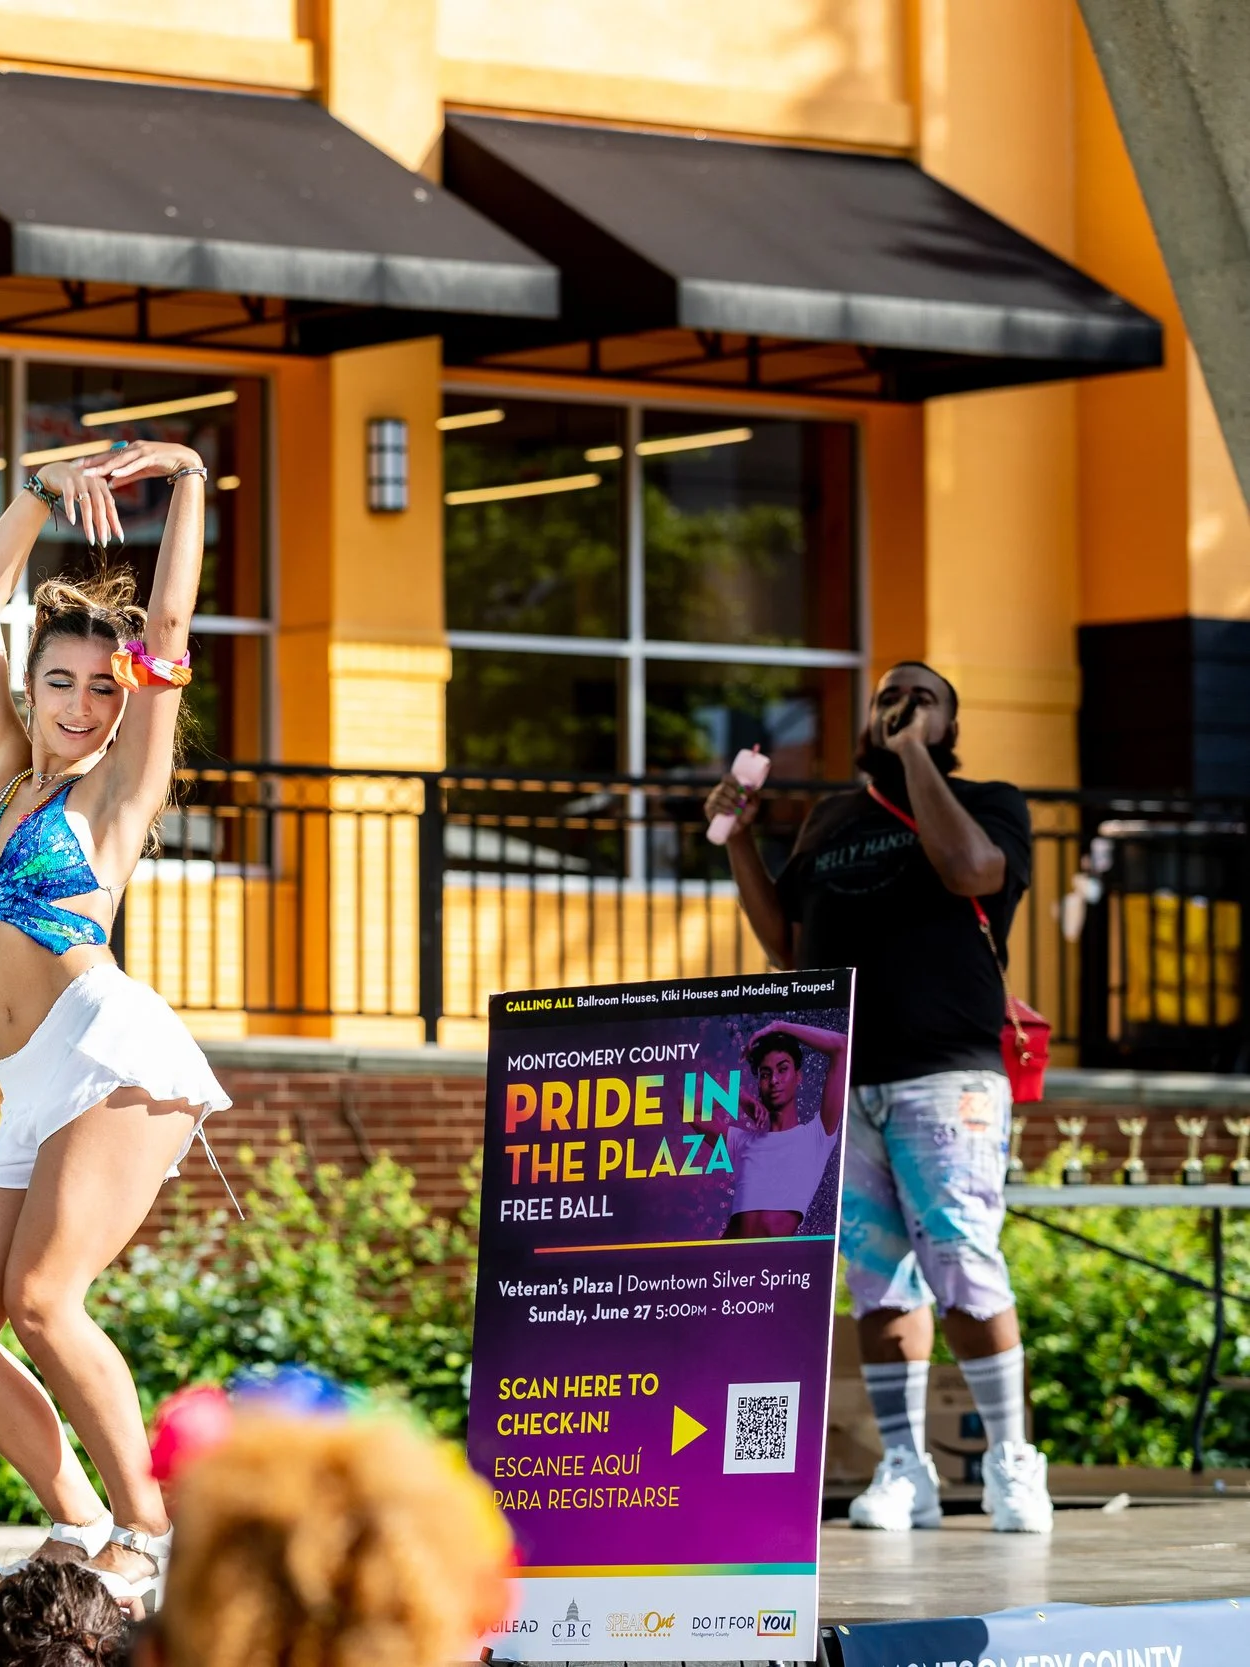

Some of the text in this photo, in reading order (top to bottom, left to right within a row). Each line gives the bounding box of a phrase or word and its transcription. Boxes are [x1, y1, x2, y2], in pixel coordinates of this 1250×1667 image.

[815, 842, 860, 873] HELLY
[506, 980, 835, 1012] CALLING ALL Ballroom Houses, Kiki Houses and Modeling Troupes!
[507, 1043, 700, 1071] MONTGOMERY COUNTY
[505, 1070, 741, 1133] PRIDE IN
[505, 1133, 734, 1185] THE PLAZA
[500, 1195, 613, 1222] FREE BALL
[499, 1278, 568, 1297] Veteran's
[573, 1276, 613, 1294] Plaza
[628, 1274, 707, 1292] Downtown
[712, 1270, 756, 1289] Silver
[760, 1269, 810, 1290] Spring
[528, 1304, 587, 1325] Sunday,
[592, 1303, 629, 1321] June
[633, 1304, 651, 1320] 27
[655, 1304, 707, 1320] 5:00PM
[721, 1299, 774, 1315] 8:00PM
[498, 1373, 659, 1400] SCAN HERE TO
[497, 1411, 610, 1436] CHECK-IN!
[494, 1447, 642, 1478] ESCANEE AQUÍ
[493, 1486, 680, 1511] PARA REGISTRARSE
[490, 1620, 538, 1633] GILEAD
[692, 1616, 791, 1631] DO IT FOR YOU
